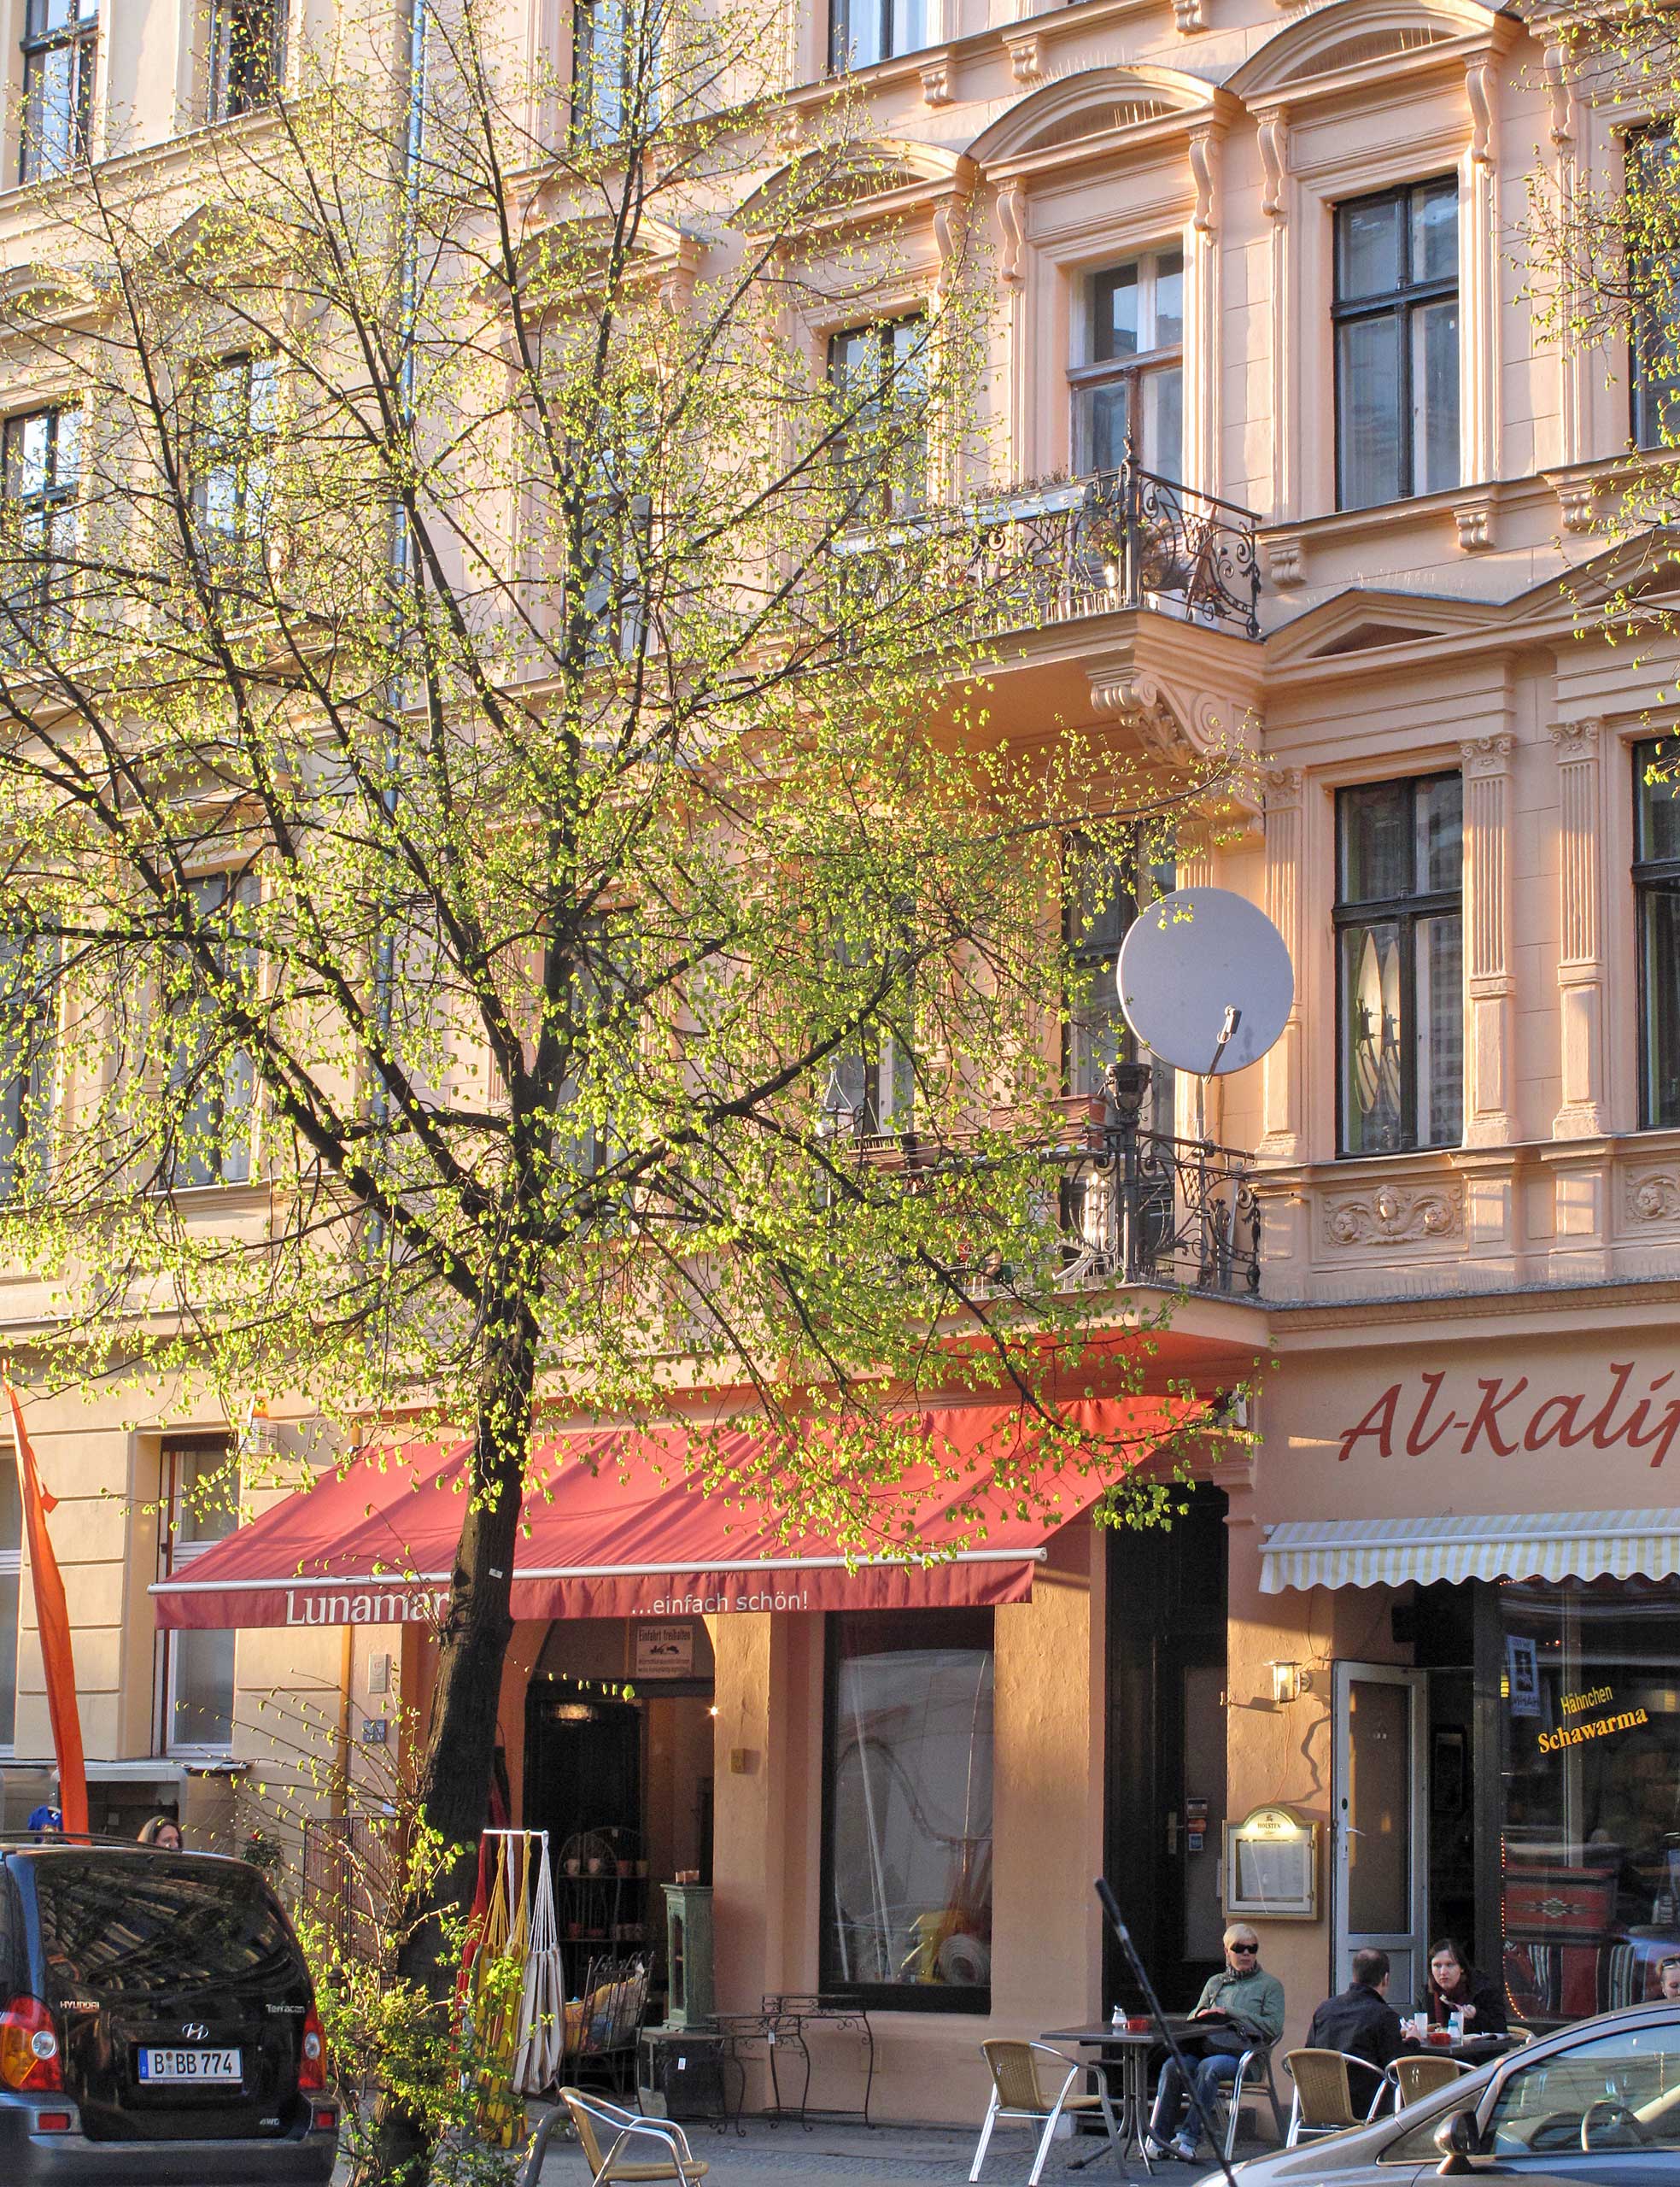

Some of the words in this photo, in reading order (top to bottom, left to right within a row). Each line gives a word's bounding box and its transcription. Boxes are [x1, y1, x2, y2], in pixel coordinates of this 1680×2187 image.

[285, 1590, 451, 1625] Lunamar
[631, 1592, 729, 1614] ...einfach
[735, 1591, 808, 1611] schön!
[1560, 1686, 1613, 1716] Hähnchen
[1537, 1708, 1648, 1754] Schawarma
[60, 2000, 100, 2009] HYUNDAI
[155, 2053, 165, 2074] B
[176, 2053, 197, 2074] BB
[201, 2053, 233, 2074] 774
